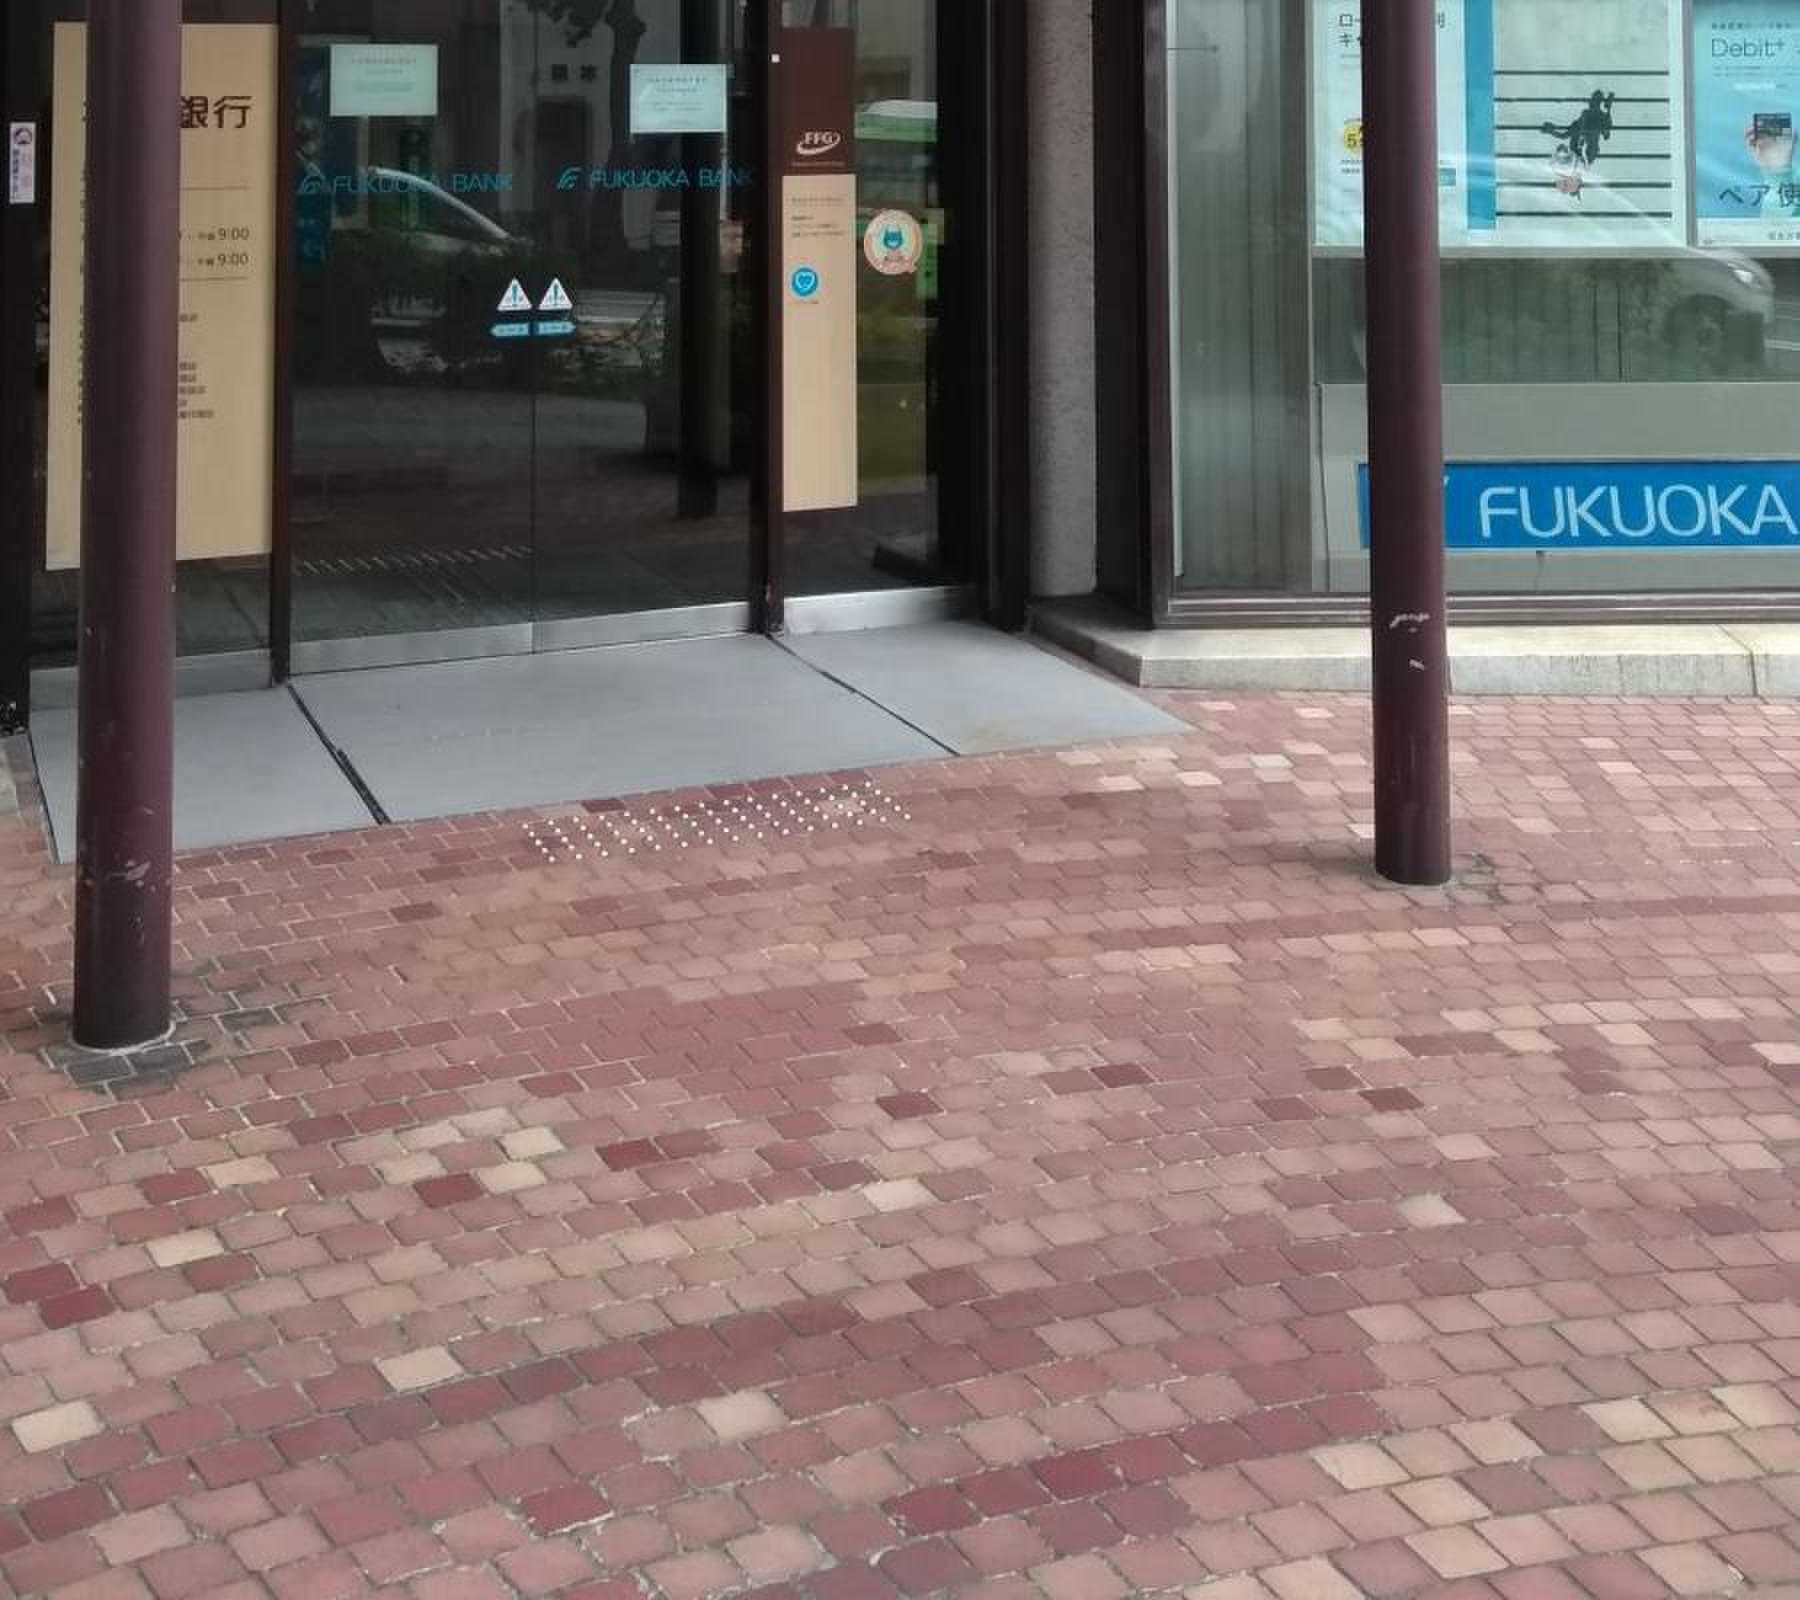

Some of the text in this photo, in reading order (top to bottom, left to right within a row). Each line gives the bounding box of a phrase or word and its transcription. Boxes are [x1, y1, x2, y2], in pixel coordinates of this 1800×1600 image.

[803, 131, 834, 146] FFG
[452, 173, 514, 192] BANK
[589, 168, 689, 188] FUKUOKA
[1478, 482, 1800, 539] FUKUOKA
